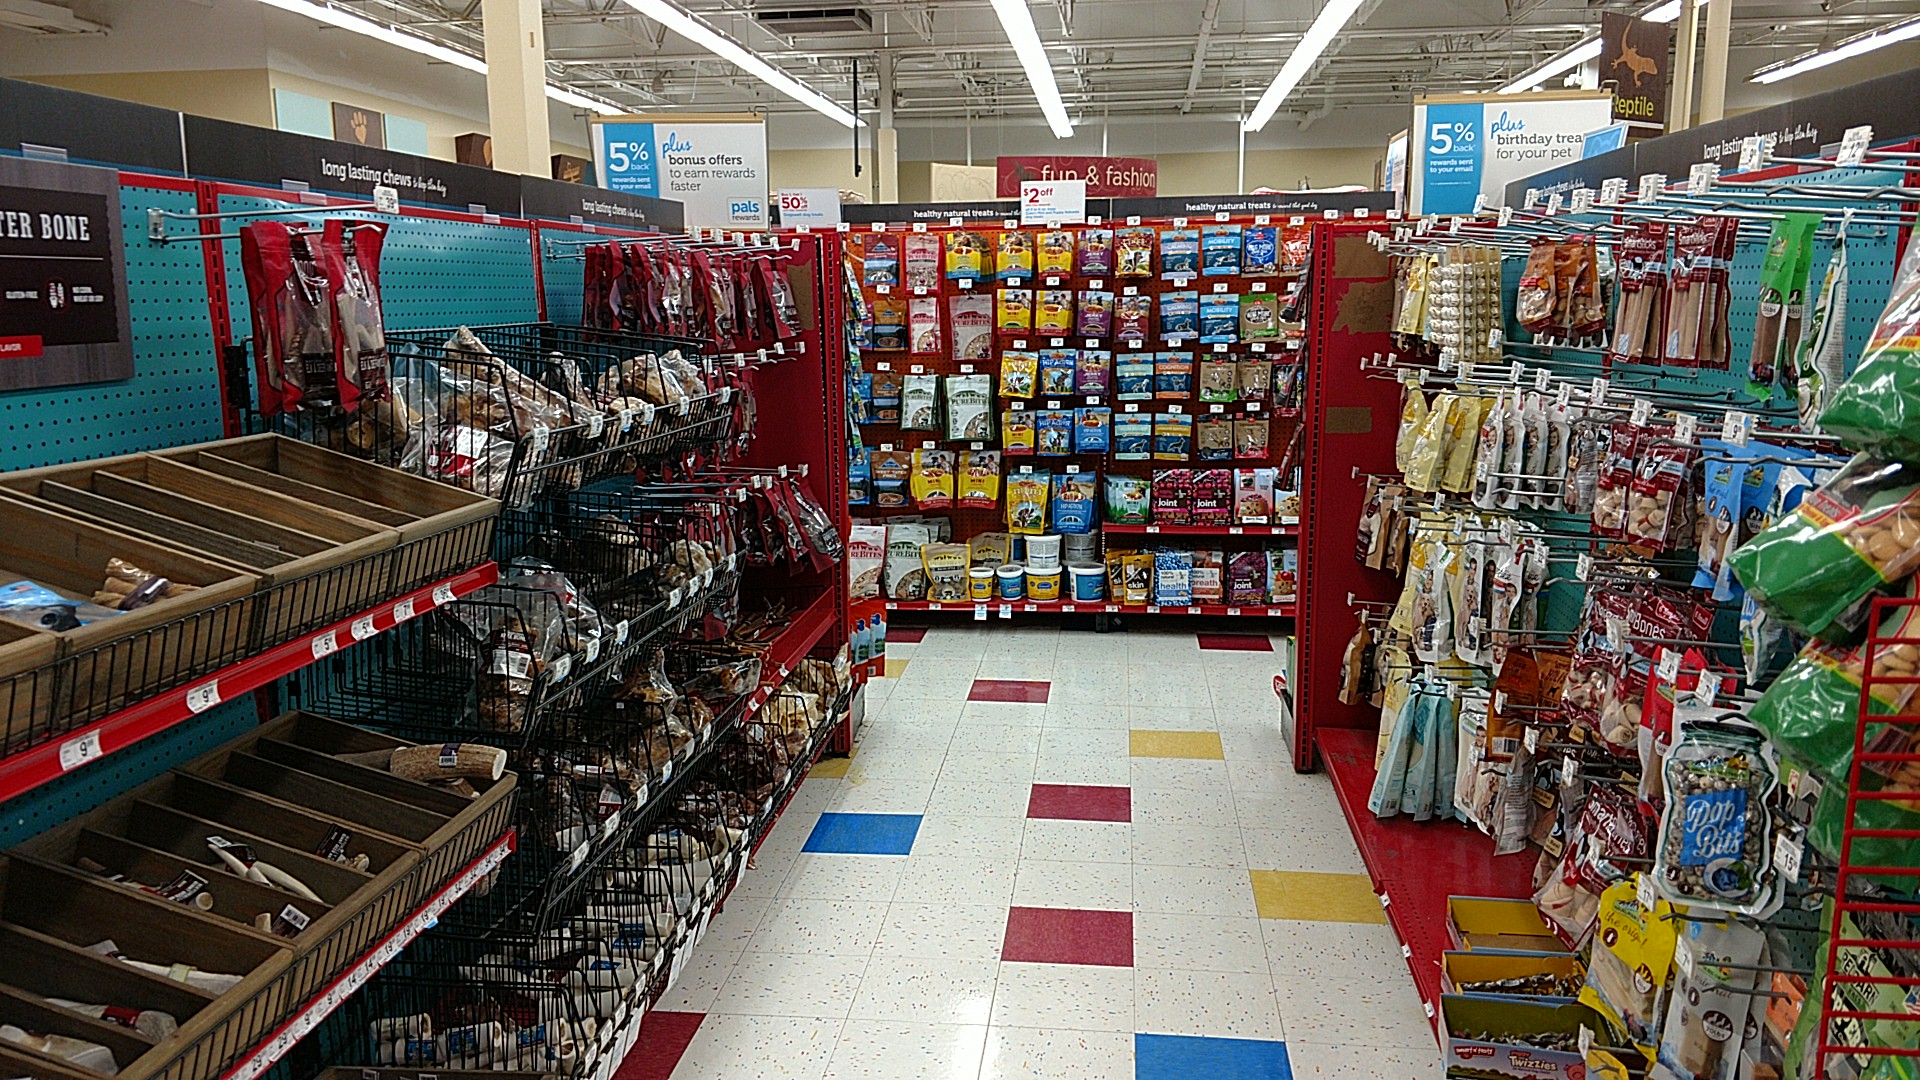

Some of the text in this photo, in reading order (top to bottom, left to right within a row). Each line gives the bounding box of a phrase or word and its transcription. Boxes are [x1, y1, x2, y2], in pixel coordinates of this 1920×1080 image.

[1490, 111, 1525, 139] plus
[662, 132, 692, 159] plus
[1429, 122, 1475, 154] 5%
[1497, 132, 1584, 148] birthday trea
[1496, 147, 1573, 162] for your pet
[1703, 143, 1720, 160] long
[1721, 136, 1744, 157] lastin
[609, 142, 650, 172] 5%
[668, 154, 744, 165] bonus offers
[321, 158, 346, 181] long
[348, 163, 382, 186] lasting
[382, 169, 412, 186] chews
[670, 168, 756, 179] to earn rewards
[1085, 165, 1100, 186] &
[1105, 164, 1156, 190] fashion
[671, 180, 702, 191] faster
[781, 197, 808, 209] 50%
[1023, 187, 1053, 204] $2 off
[731, 201, 760, 215] pals
[913, 210, 942, 219] healthy
[942, 209, 970, 218] natural
[971, 209, 994, 217] treats
[1186, 203, 1216, 212] healthy
[1217, 202, 1247, 210] natural
[1247, 201, 1271, 210] treats
[40, 213, 91, 241] BONE
[1157, 498, 1179, 509] joint
[1196, 498, 1218, 509] joint
[1160, 583, 1188, 591] health
[1233, 581, 1252, 590] joint
[1686, 799, 1736, 833] Pop
[1693, 824, 1742, 858] Bits
[1604, 911, 1622, 928] the
